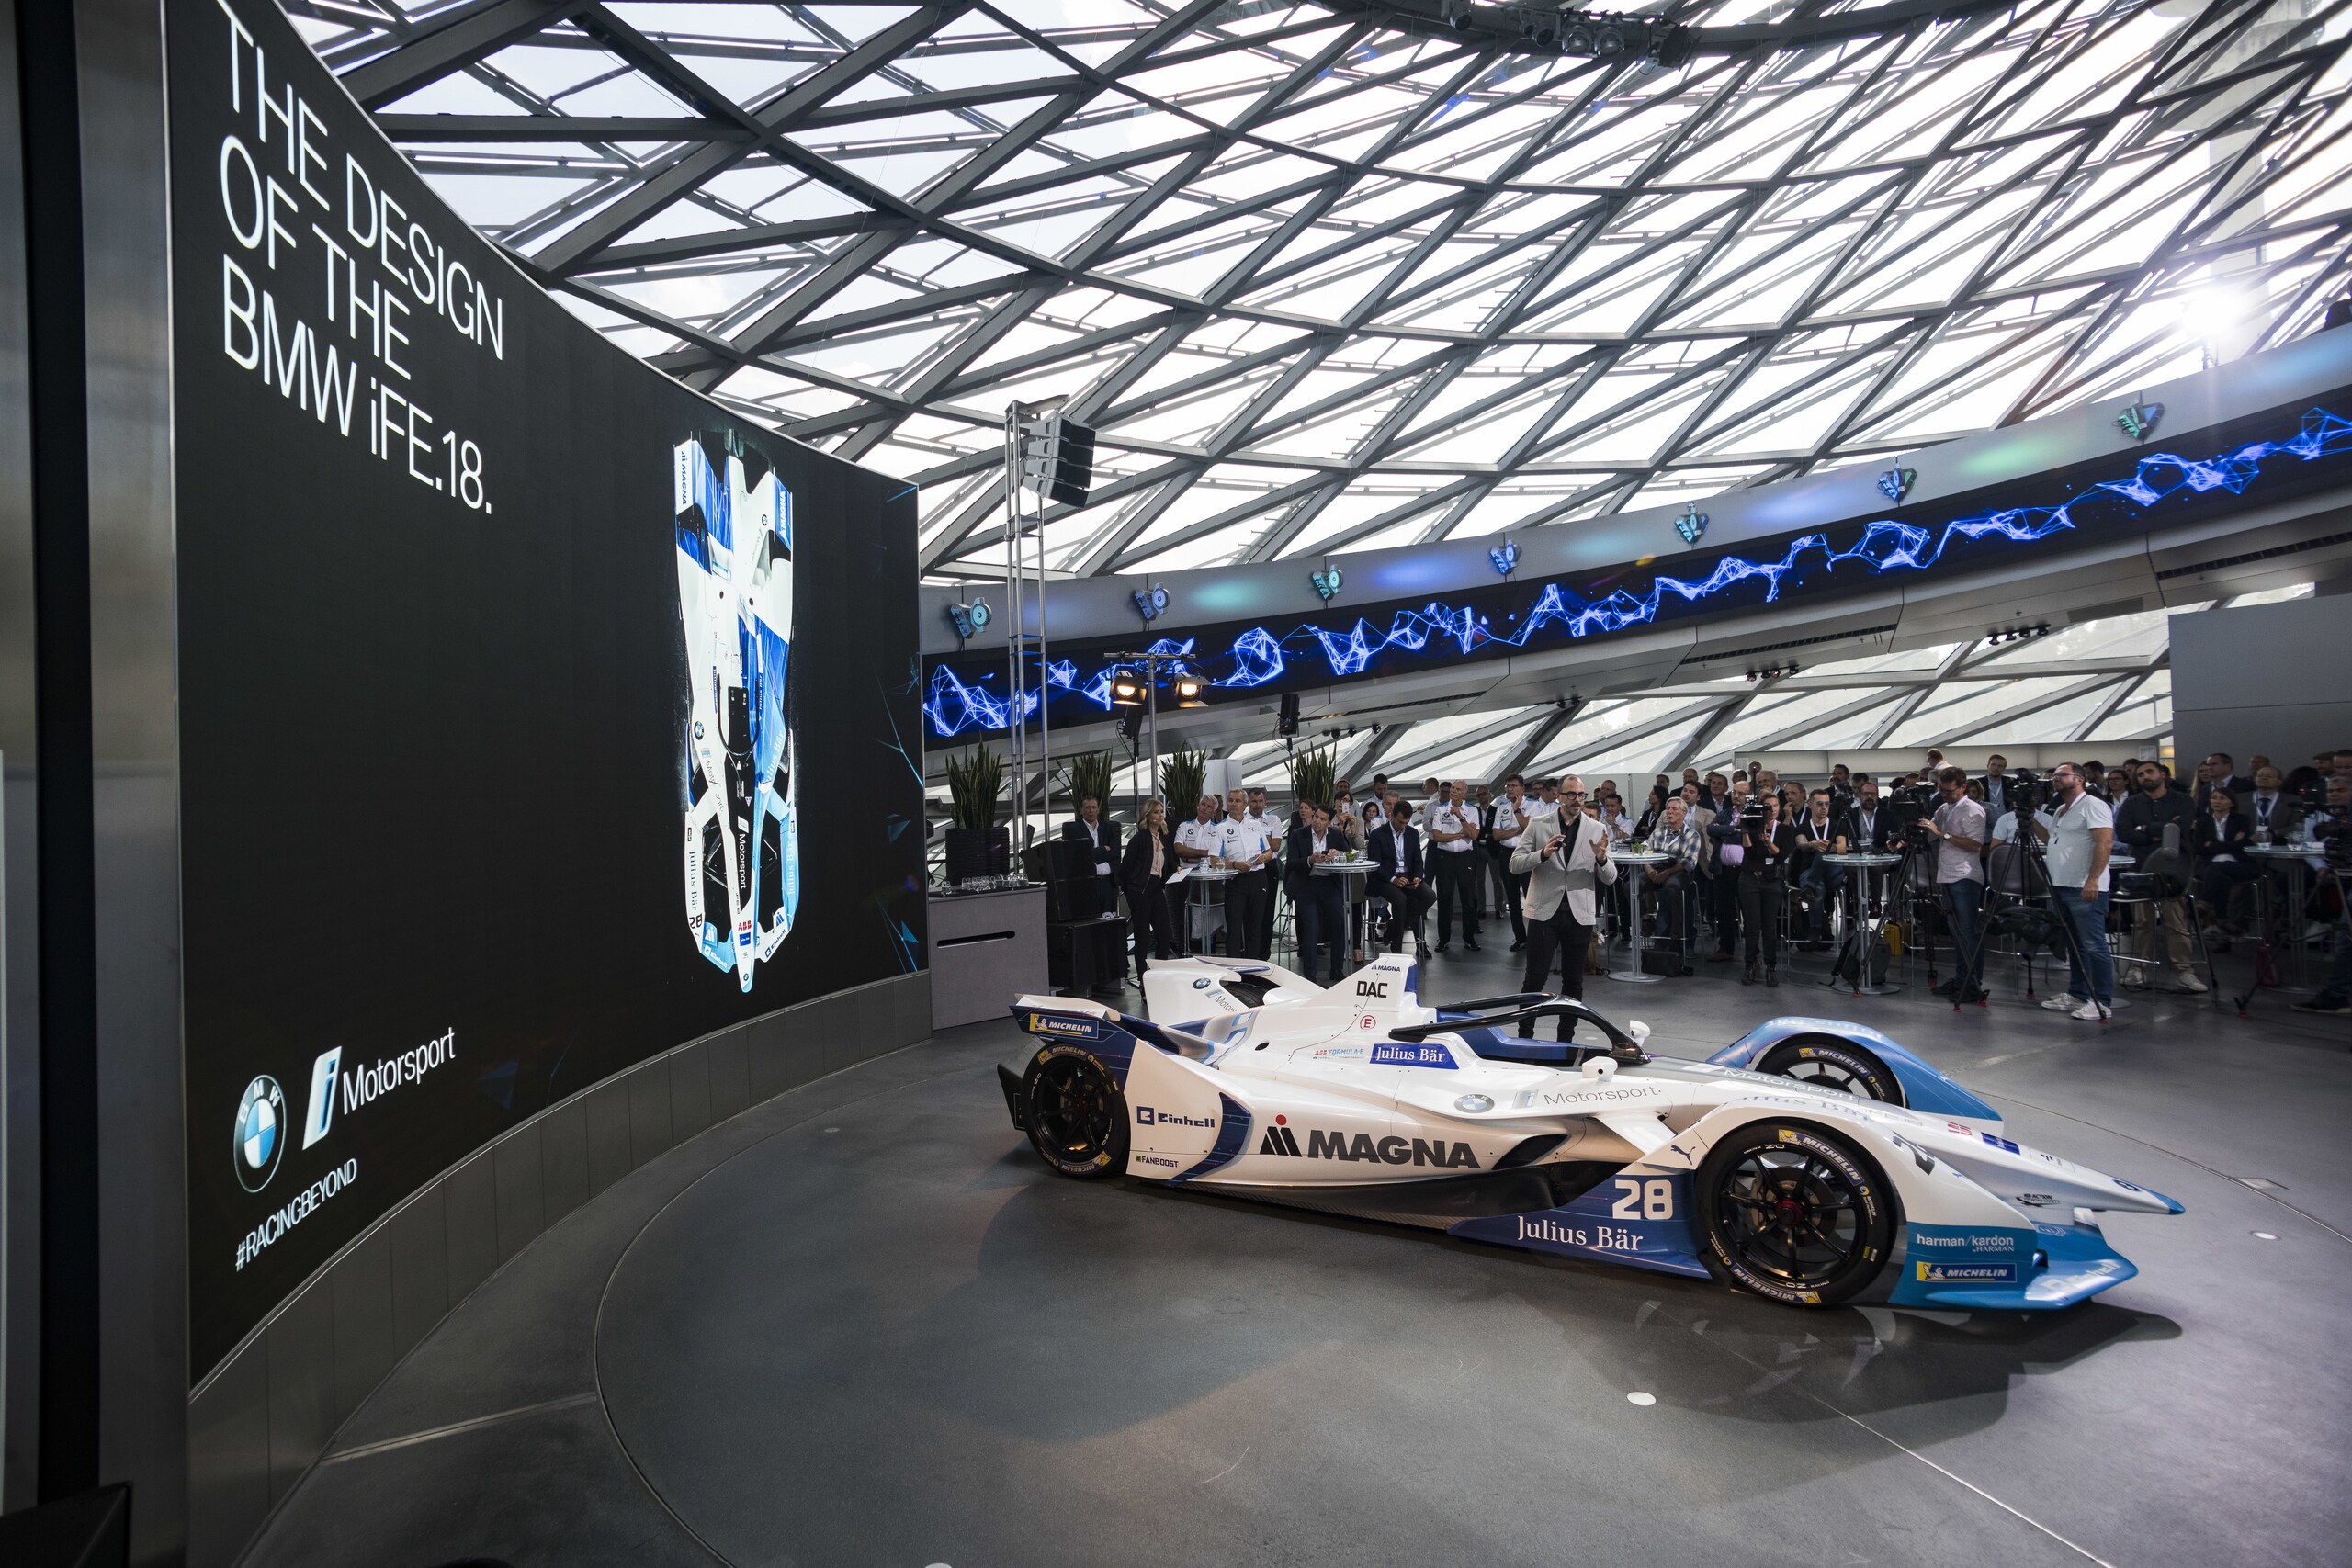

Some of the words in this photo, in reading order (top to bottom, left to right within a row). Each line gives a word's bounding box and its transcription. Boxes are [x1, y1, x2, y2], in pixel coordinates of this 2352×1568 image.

[218, 0, 331, 212] THE
[346, 152, 503, 361] DESIGN
[220, 134, 299, 270] OF
[311, 222, 412, 381] THE
[223, 254, 357, 438] BMW
[370, 376, 492, 514] iFE.18.
[739, 833, 747, 890] Motorsport
[738, 920, 752, 931] ABB
[1378, 964, 1401, 973] MAGNA
[1356, 980, 1388, 998] DAC
[1048, 1021, 1092, 1033] MICHELIN
[1051, 1045, 1087, 1057] MICHELIN
[1376, 1047, 1415, 1061] Julius
[1419, 1048, 1446, 1063] Bär
[1818, 1048, 1868, 1075] MICHELIN
[343, 1026, 456, 1115] Motorsport
[1724, 1069, 1857, 1101] Motorsport
[1158, 1112, 1216, 1128] Einhell
[1141, 1156, 1179, 1168] FANBOOST
[1307, 1129, 1482, 1169] MAGNA
[1802, 1136, 1861, 1182] MICHELIN
[235, 1157, 357, 1272] #RACINGBEYOND
[1612, 1179, 1674, 1221] 28
[1517, 1215, 1588, 1247] Julius
[1596, 1225, 1645, 1252] Bär
[1733, 1268, 1796, 1302] MICHELIN
[1946, 1269, 2008, 1278] MICHELIN
